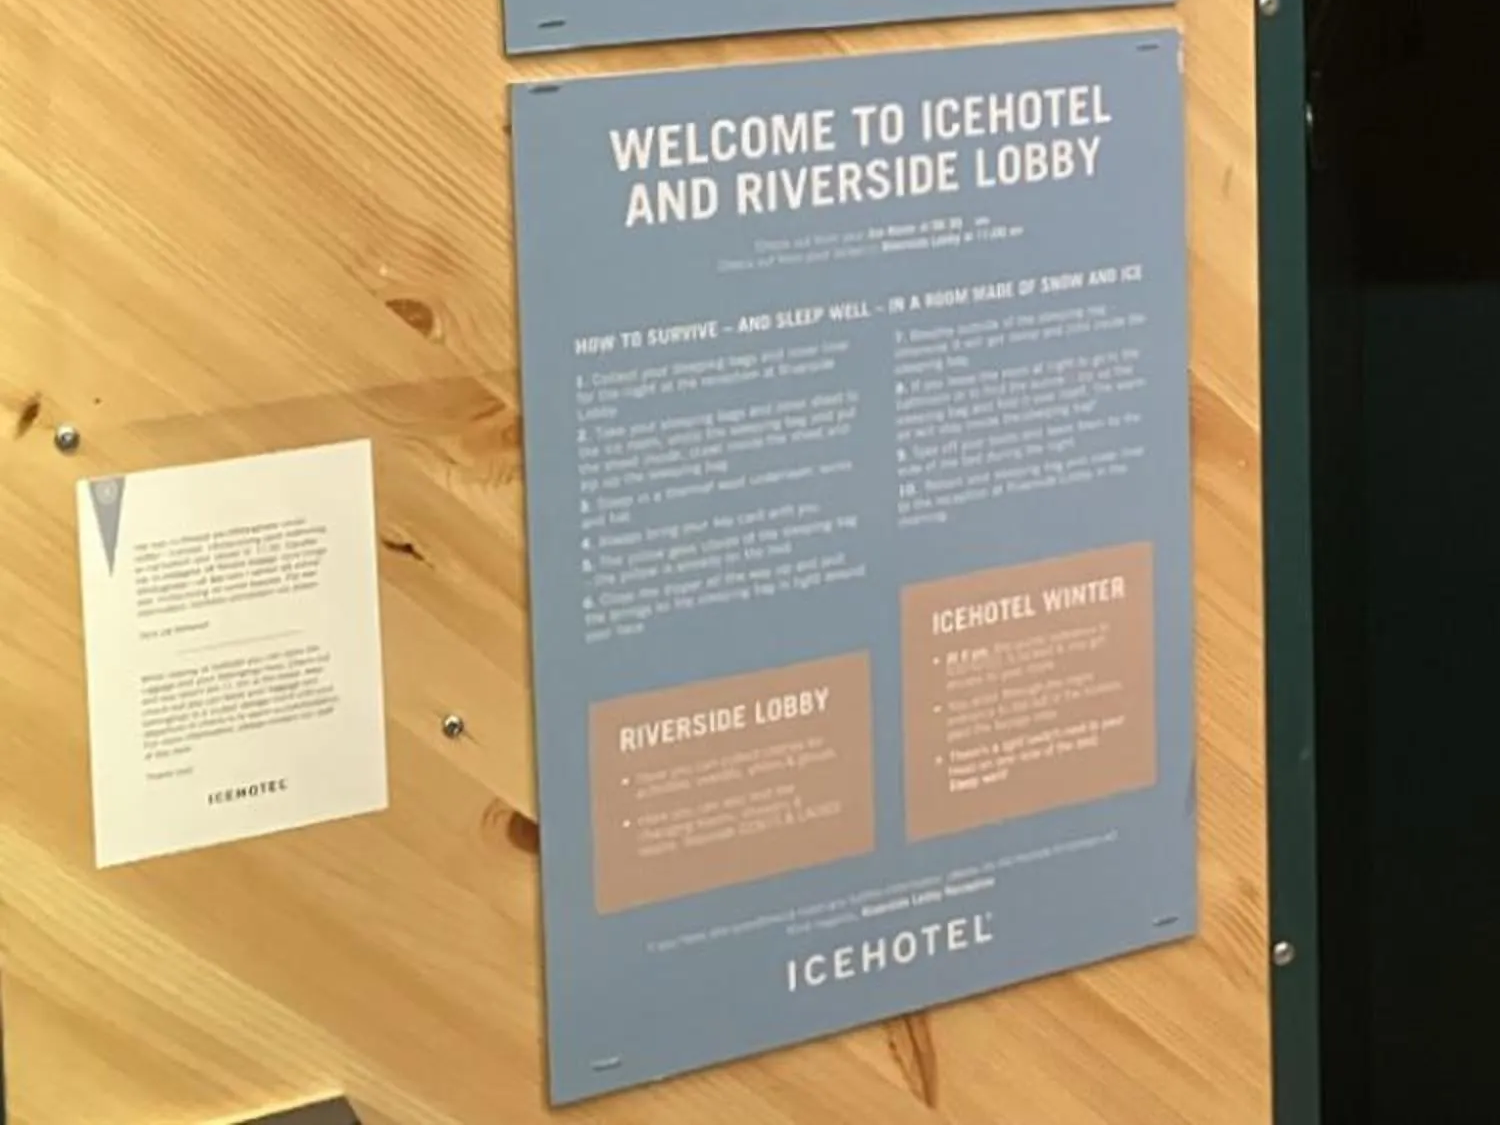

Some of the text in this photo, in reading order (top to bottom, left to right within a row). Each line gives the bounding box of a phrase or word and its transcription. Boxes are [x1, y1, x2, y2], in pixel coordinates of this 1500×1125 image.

[610, 85, 1112, 171] WELCOME TO ICEHOTEL
[624, 136, 1101, 228] AND RIVERSIDE LOBBY
[575, 336, 616, 355] HOW
[621, 331, 641, 349] TO
[647, 320, 719, 345] SURVIVE
[737, 313, 771, 333] AND
[776, 306, 825, 329] SLEEP
[830, 301, 870, 322] WELL
[889, 296, 905, 314] IN
[909, 295, 921, 311] A
[925, 287, 967, 309] ROOM
[972, 281, 1013, 302] MADE
[1019, 278, 1036, 295] OF
[1040, 272, 1084, 294] SNOW
[1088, 268, 1116, 287] AND
[1121, 264, 1142, 283] ICE
[932, 576, 1126, 635] ICEHOTEL WINTER
[619, 687, 829, 752] RIVERSIDE LOBBY
[787, 913, 993, 992] ICEHOTEL
